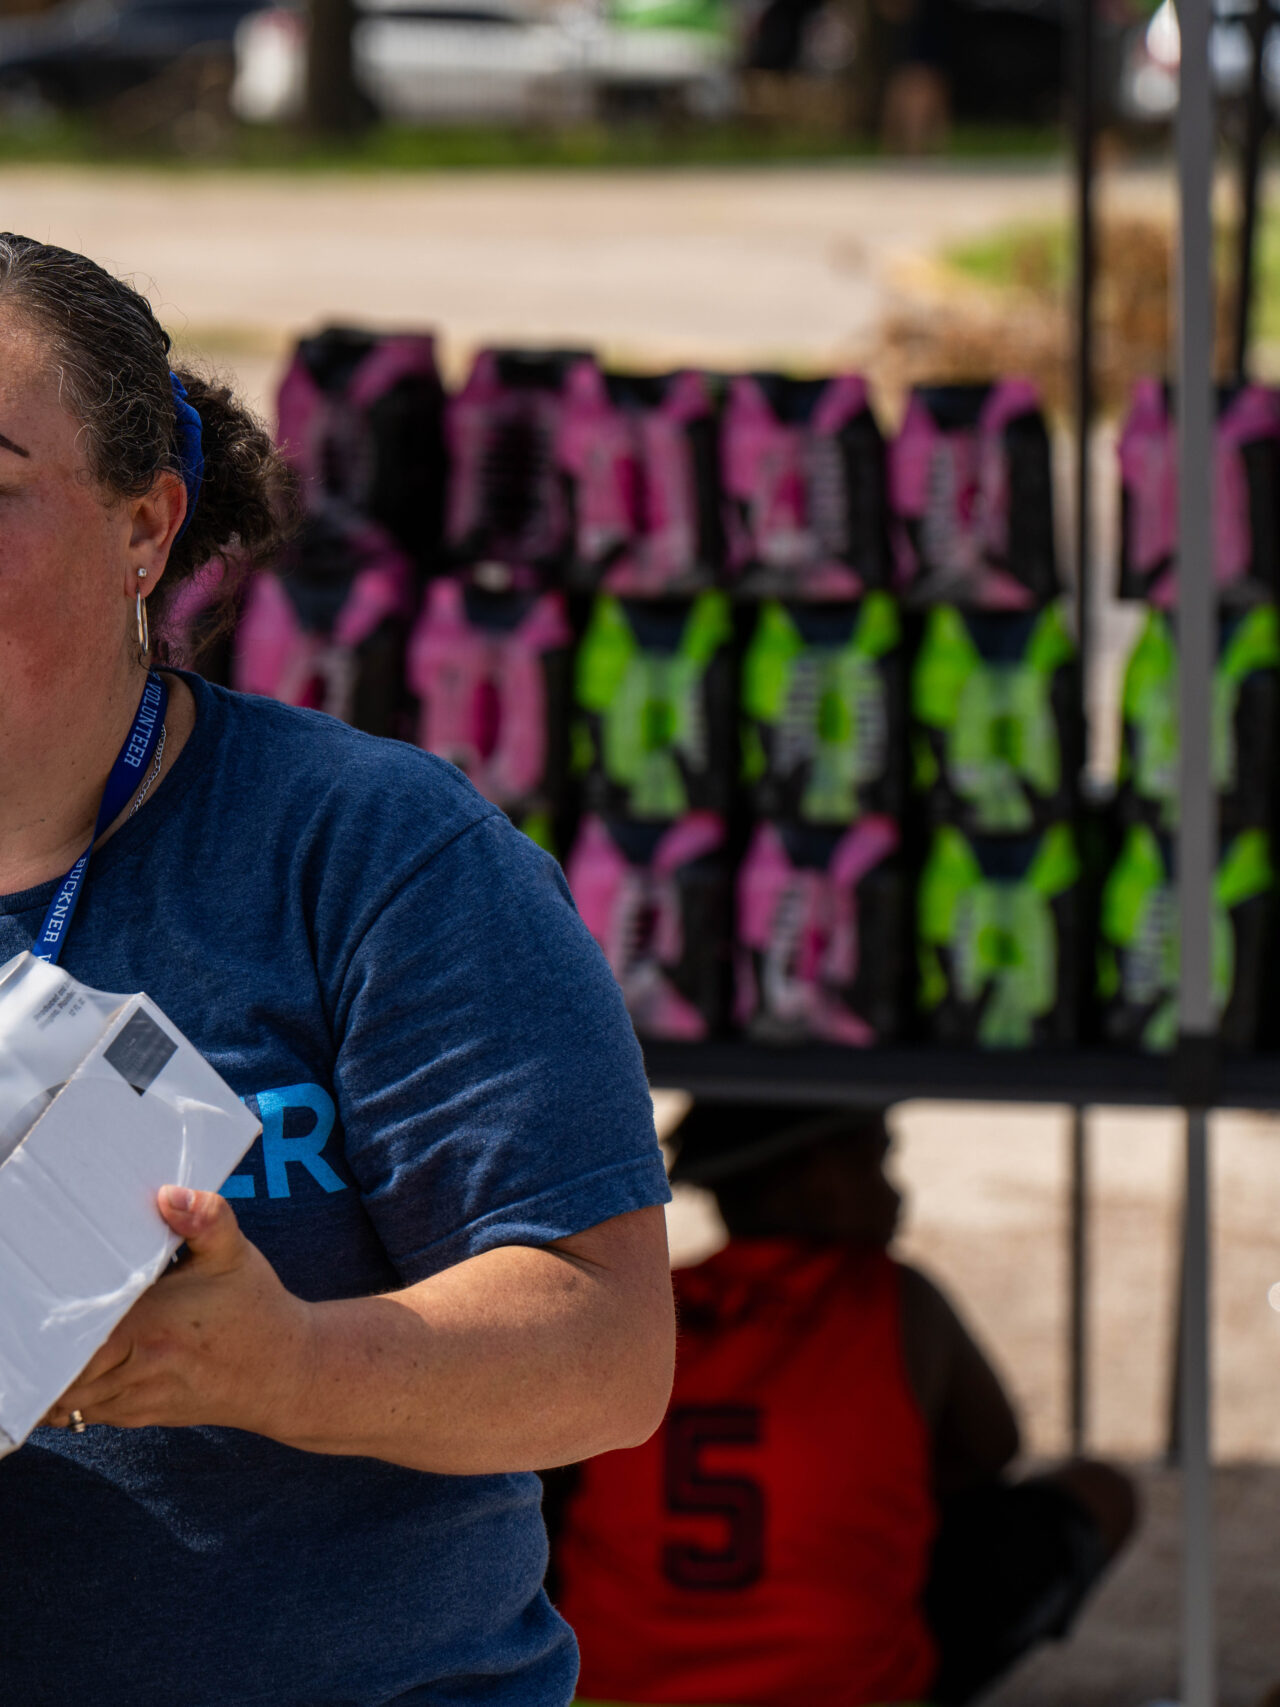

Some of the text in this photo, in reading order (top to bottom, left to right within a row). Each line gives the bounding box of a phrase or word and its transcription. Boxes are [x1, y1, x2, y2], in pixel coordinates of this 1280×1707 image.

[124, 681, 162, 768] VOLUNTEER
[43, 857, 87, 943] BUCKNER
[663, 1407, 766, 1592] 5
